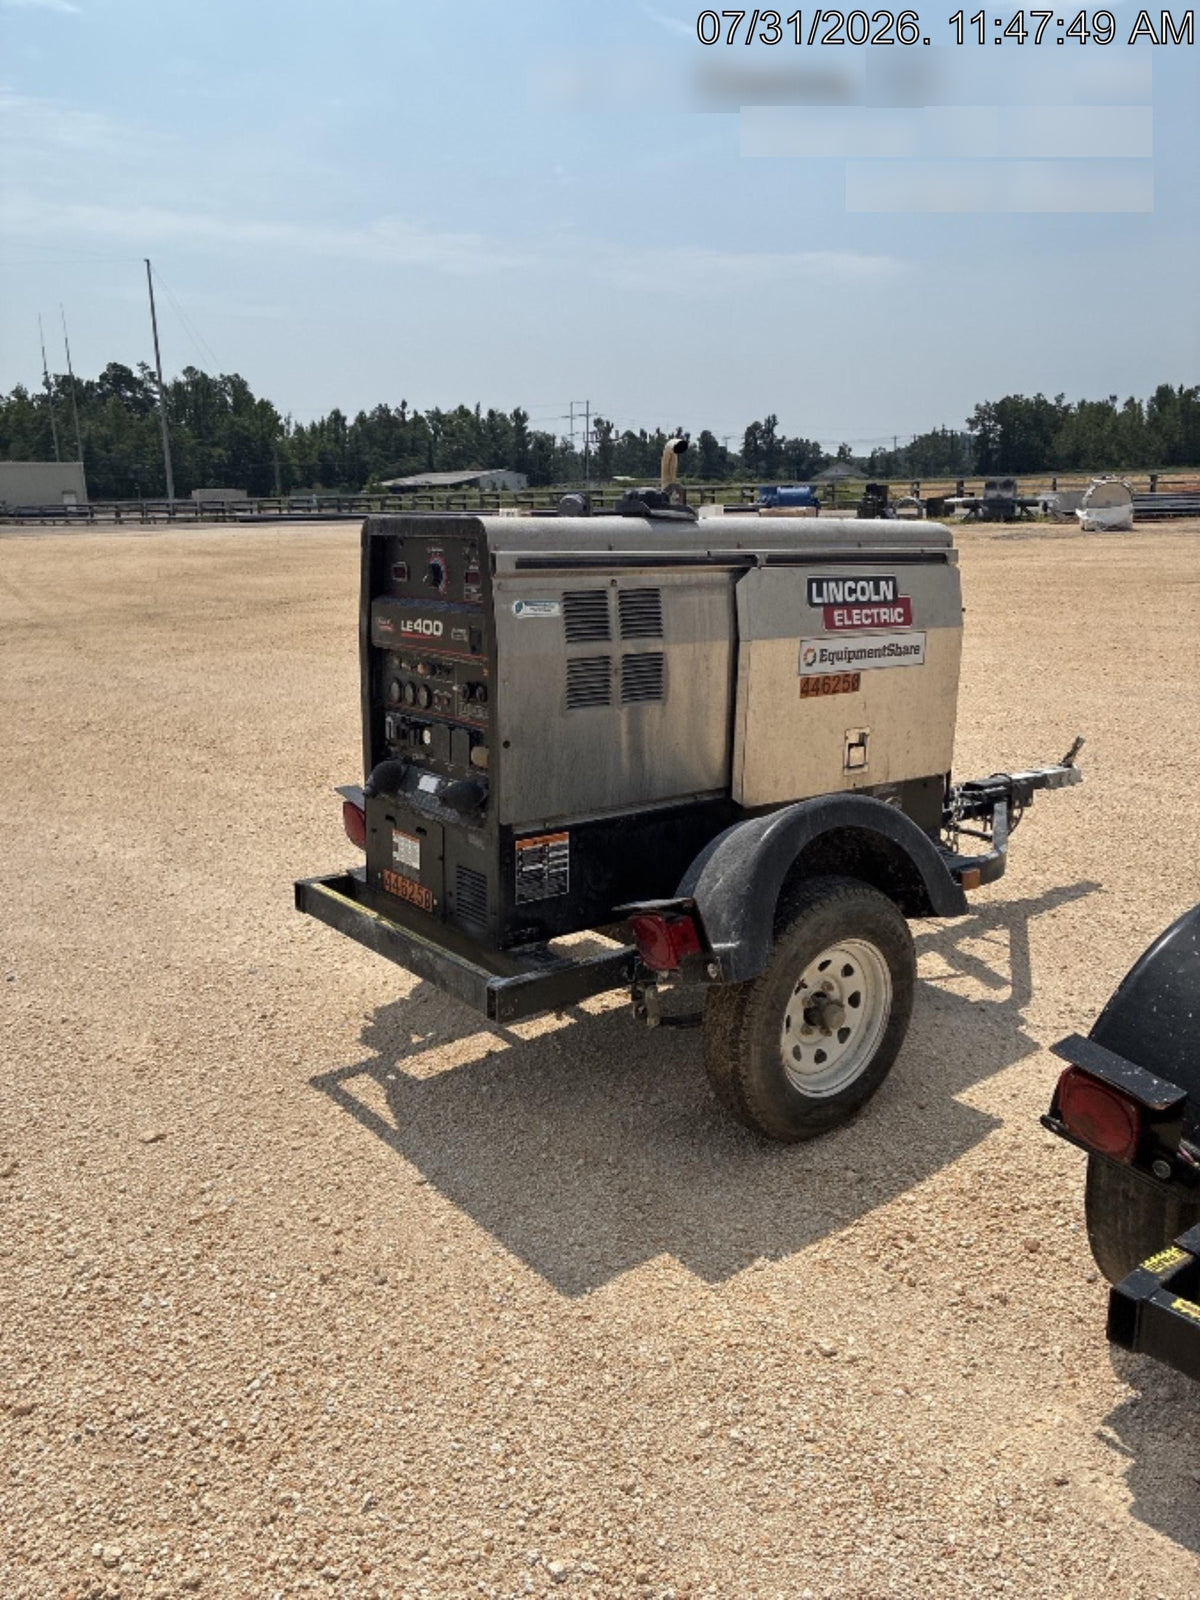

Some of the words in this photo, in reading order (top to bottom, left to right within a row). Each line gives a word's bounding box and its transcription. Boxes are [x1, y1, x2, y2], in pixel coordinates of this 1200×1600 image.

[812, 580, 894, 604] LINCOLN
[401, 618, 444, 637] LE400
[833, 607, 905, 627] ELECTRIC
[819, 643, 920, 665] EquipmentShare
